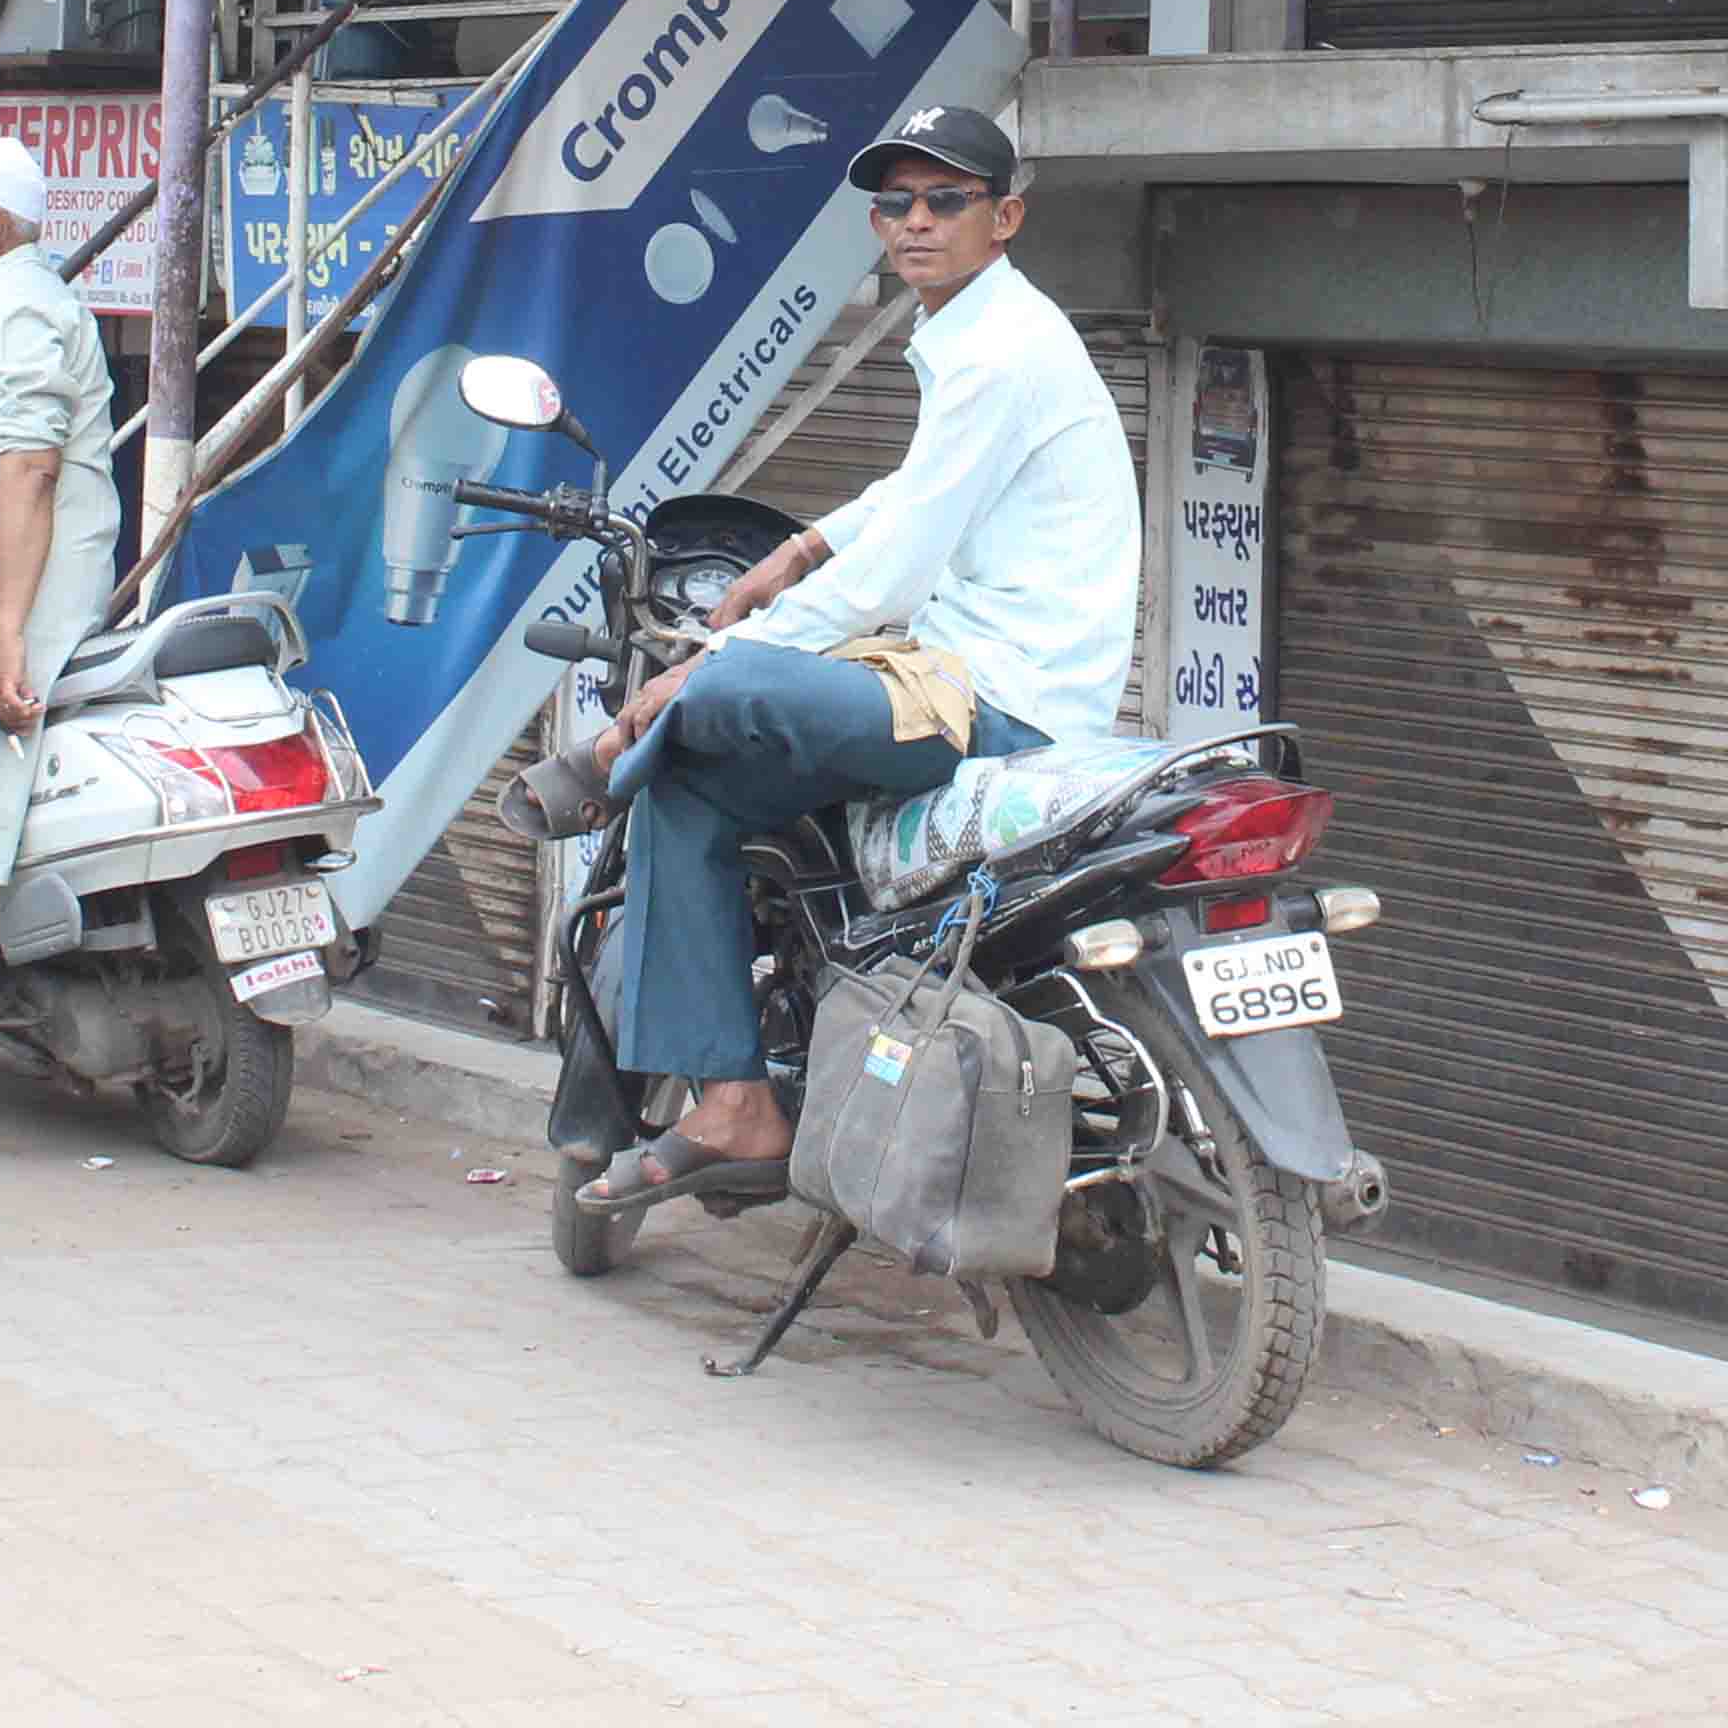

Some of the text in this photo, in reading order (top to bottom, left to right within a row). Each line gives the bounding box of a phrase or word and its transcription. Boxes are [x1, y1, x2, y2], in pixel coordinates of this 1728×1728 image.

[656, 279, 819, 489] Electricals
[1193, 584, 1249, 627] અત્તર
[1175, 649, 1225, 710] બોડી
[1210, 977, 1329, 1025] 6896
